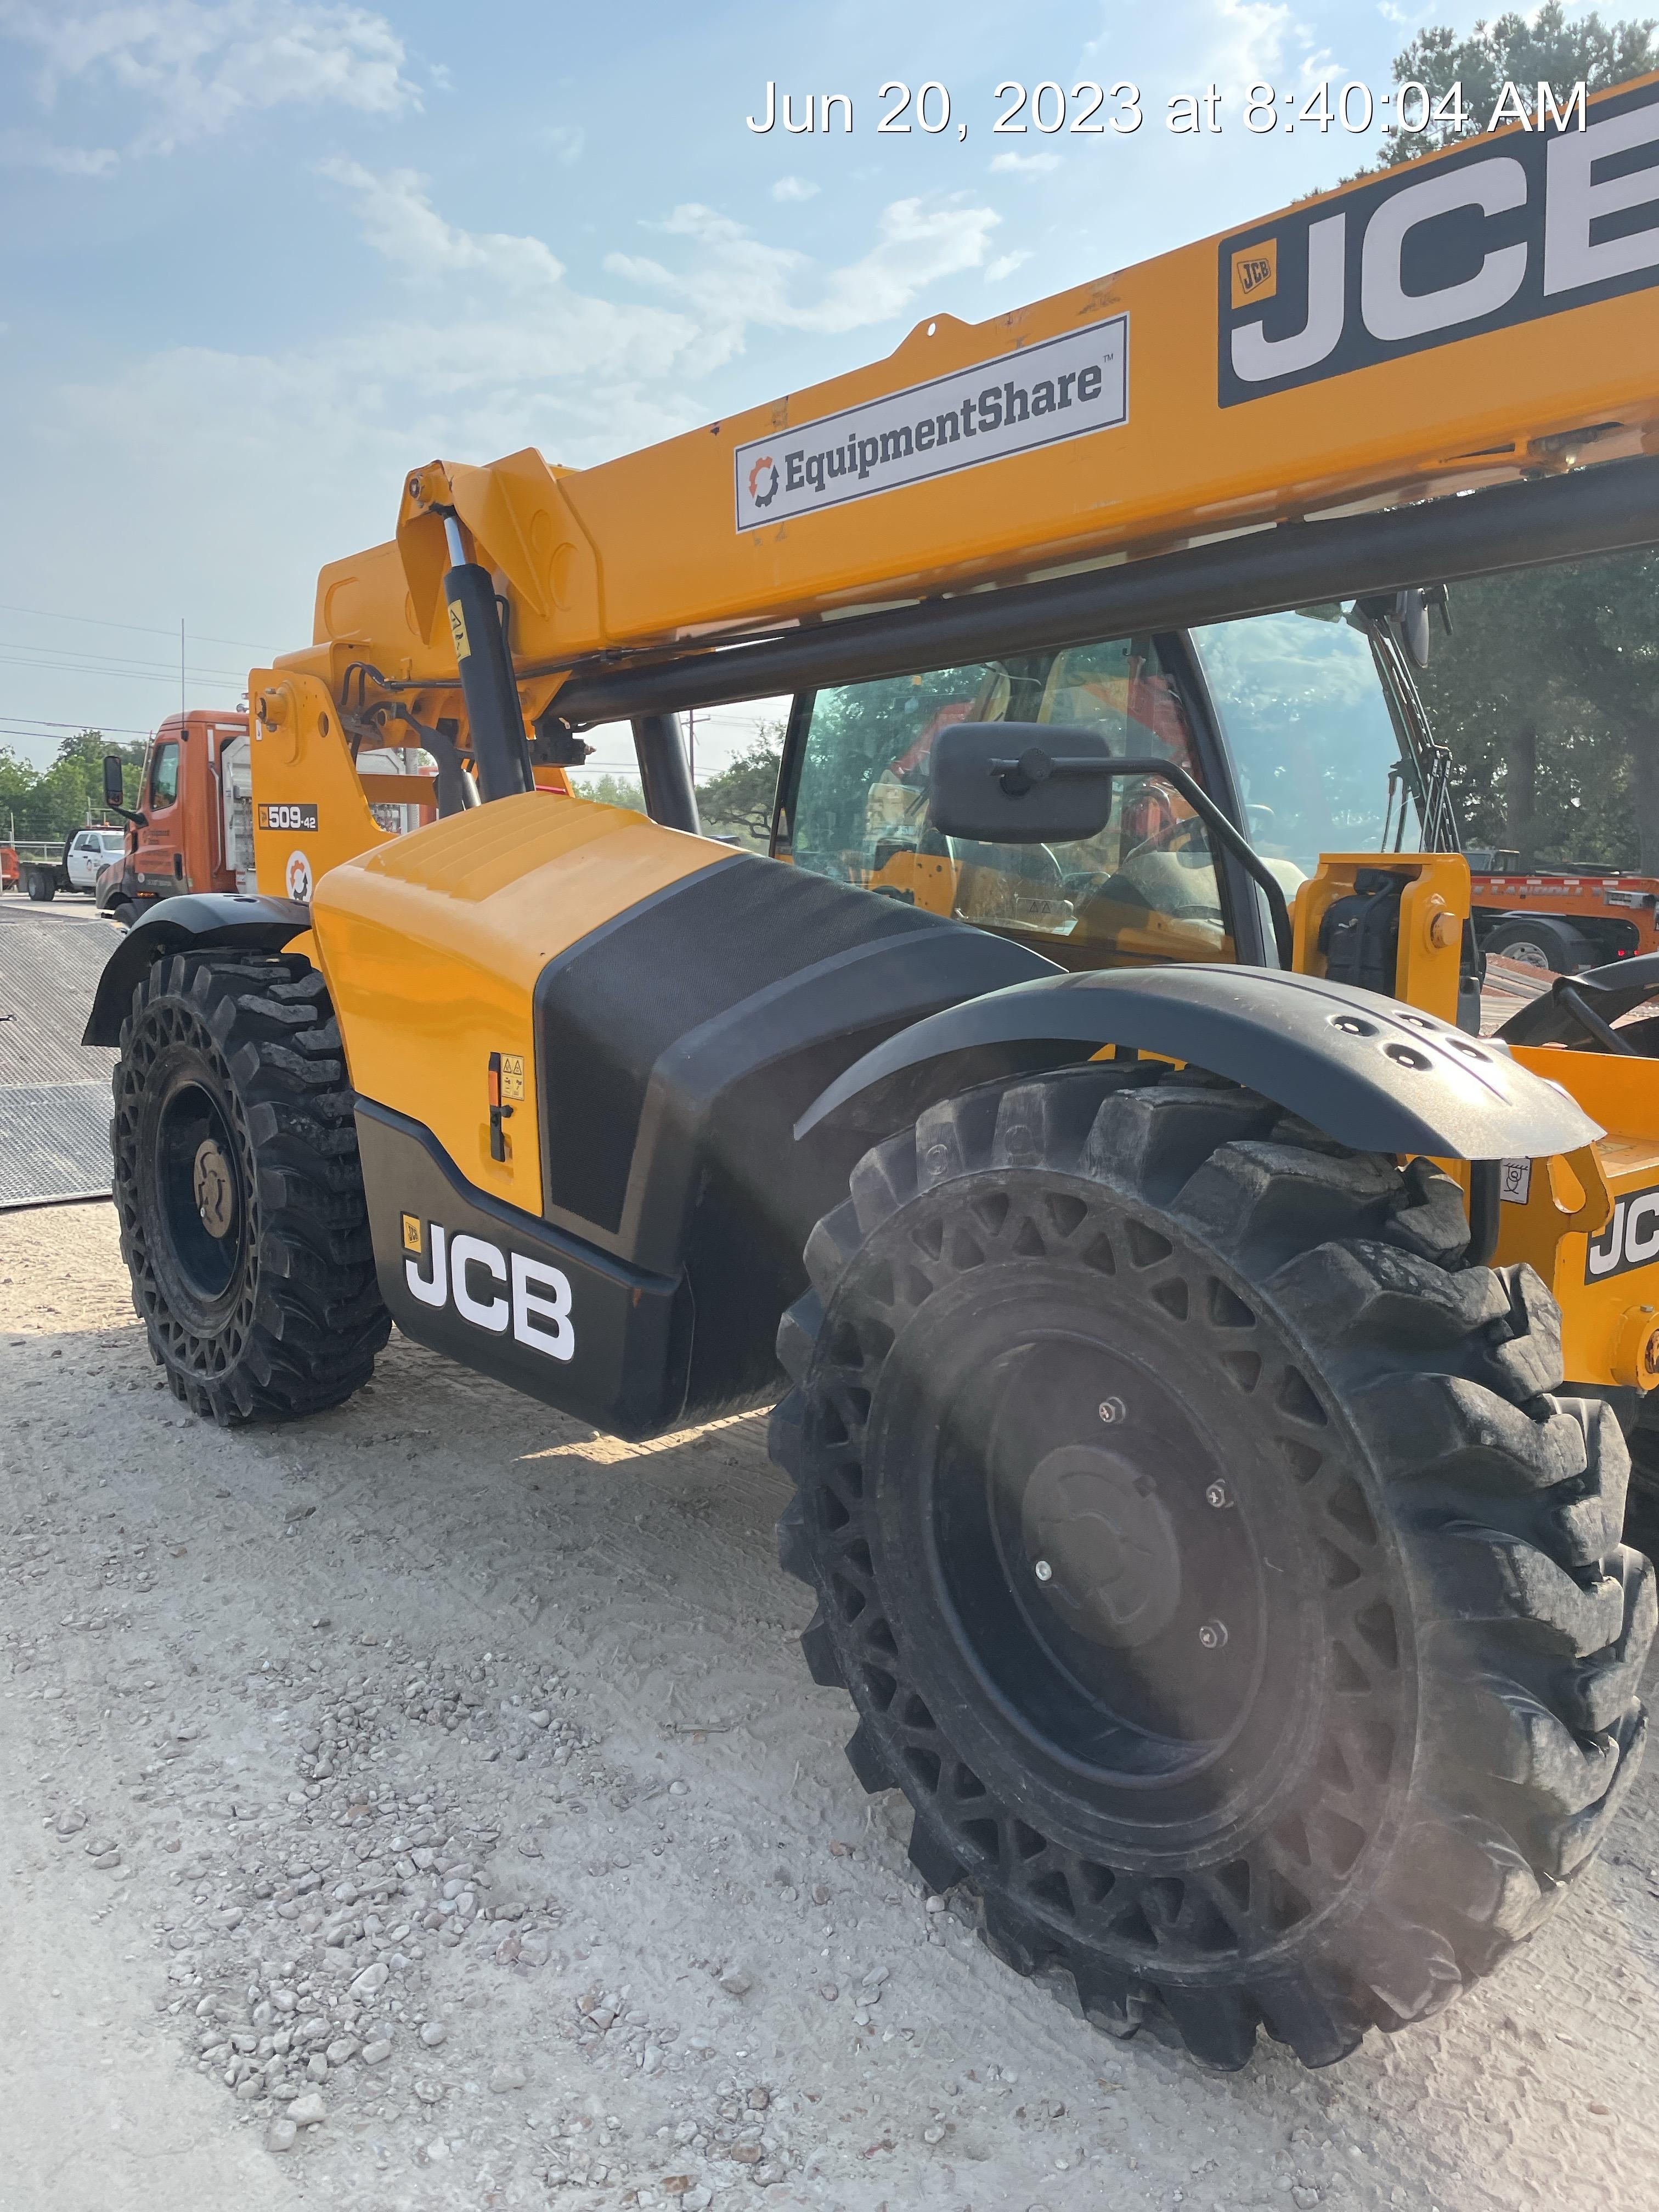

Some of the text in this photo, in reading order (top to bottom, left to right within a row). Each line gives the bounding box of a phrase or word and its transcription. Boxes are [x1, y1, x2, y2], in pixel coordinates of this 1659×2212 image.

[1243, 261, 1269, 289] JCB
[785, 365, 1102, 492] EquipmentShare
[269, 806, 316, 828] 509-42
[405, 1224, 575, 1361] JCB
